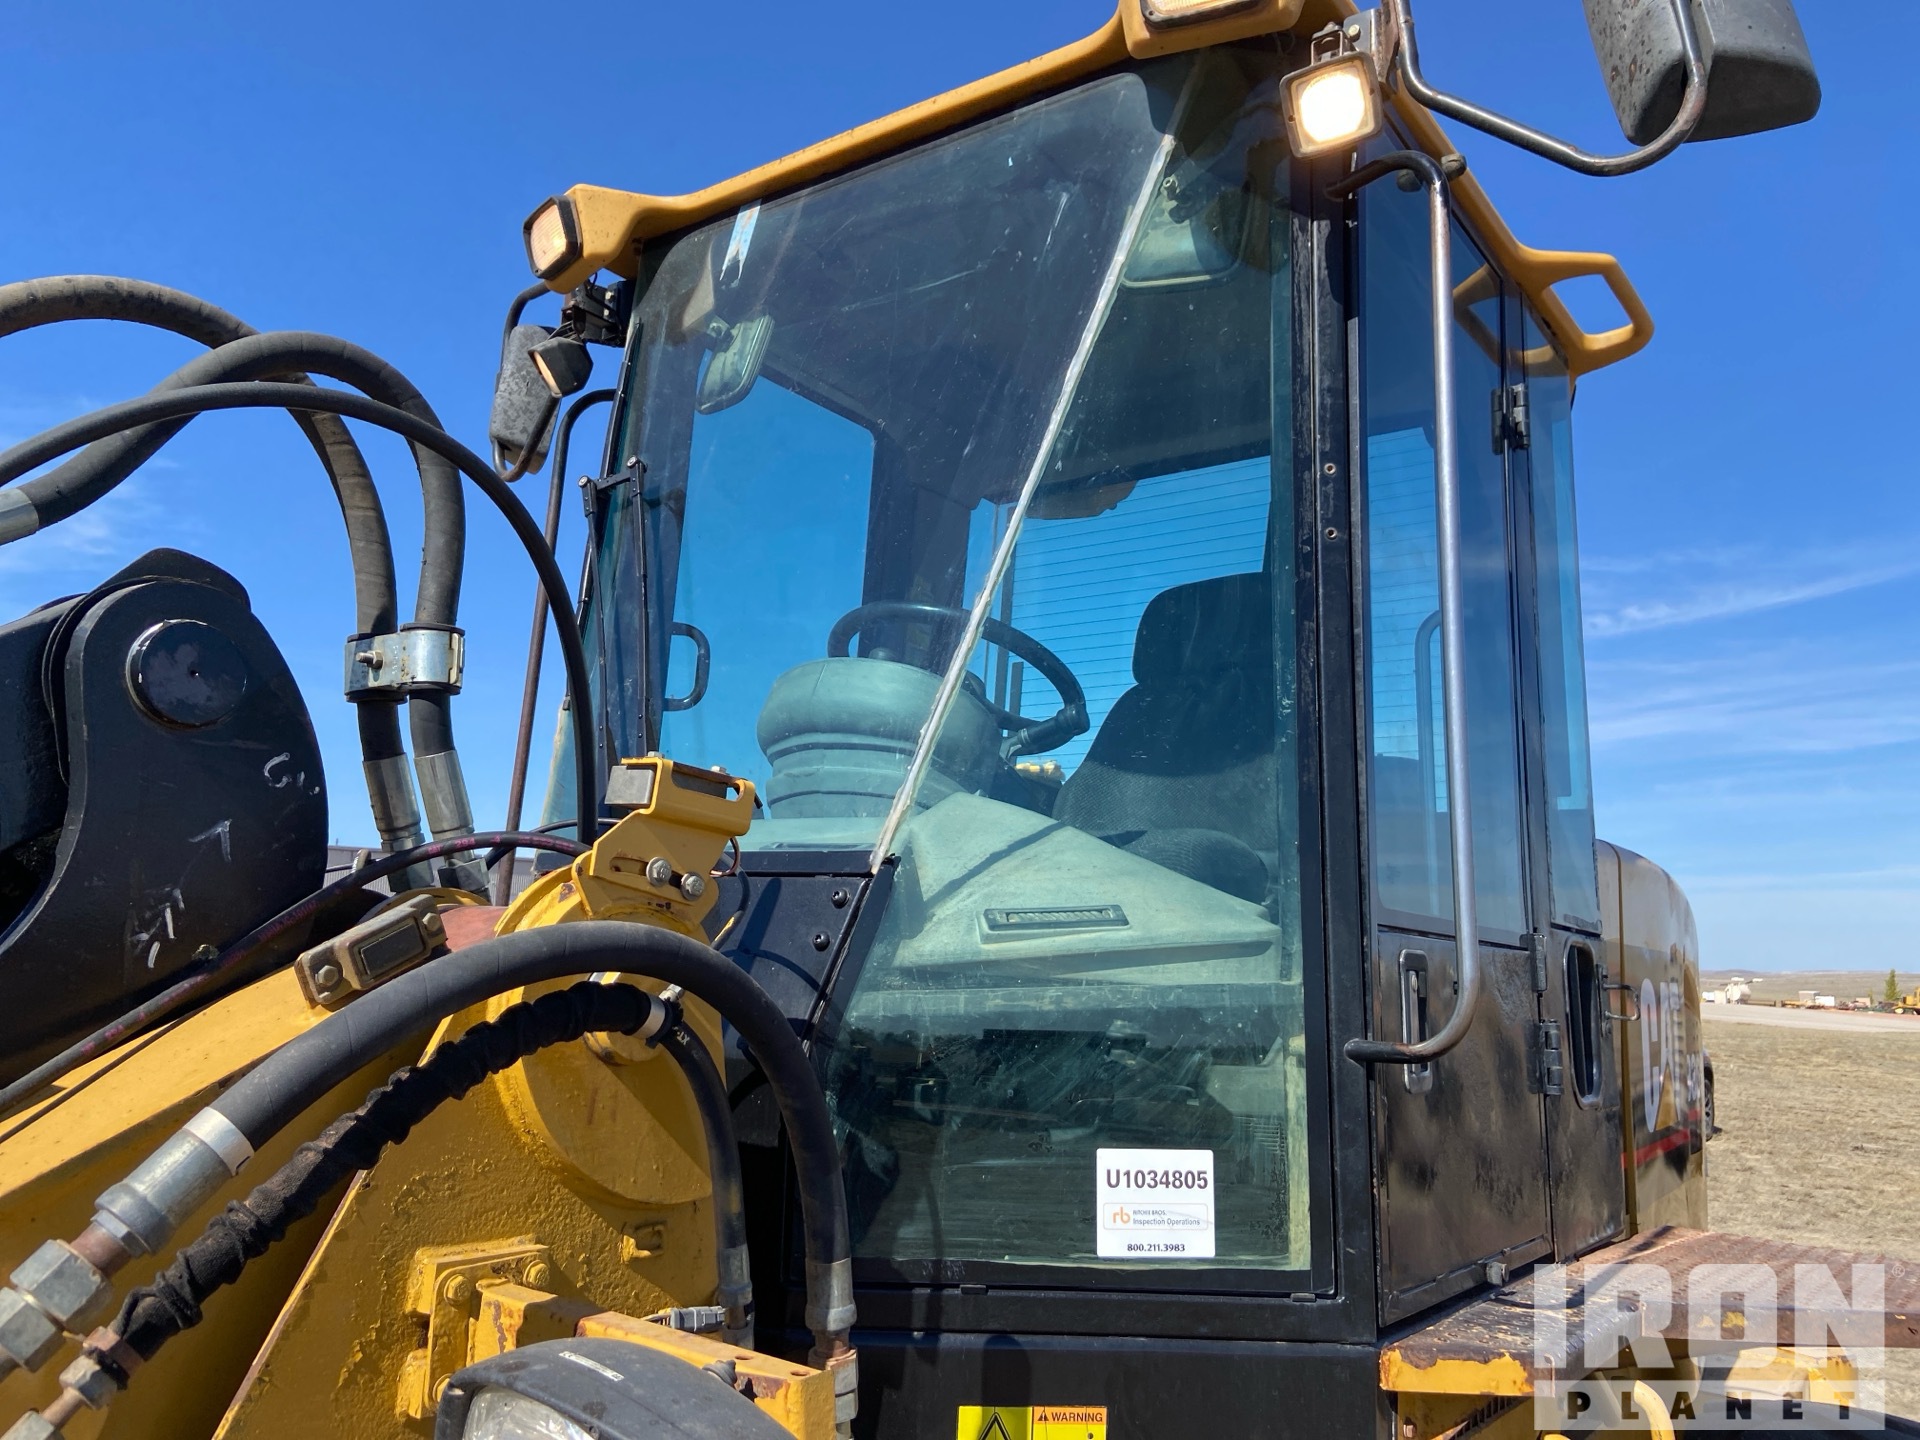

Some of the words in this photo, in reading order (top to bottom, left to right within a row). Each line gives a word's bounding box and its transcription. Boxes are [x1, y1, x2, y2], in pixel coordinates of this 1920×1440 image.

[1106, 1168, 1209, 1190] U1034805
[1112, 1206, 1131, 1224] rb
[1132, 1218, 1166, 1226] Inspection
[1166, 1218, 1201, 1226] Operations
[1127, 1243, 1186, 1252] 800.211.3983
[1051, 1411, 1103, 1423] WARNING
